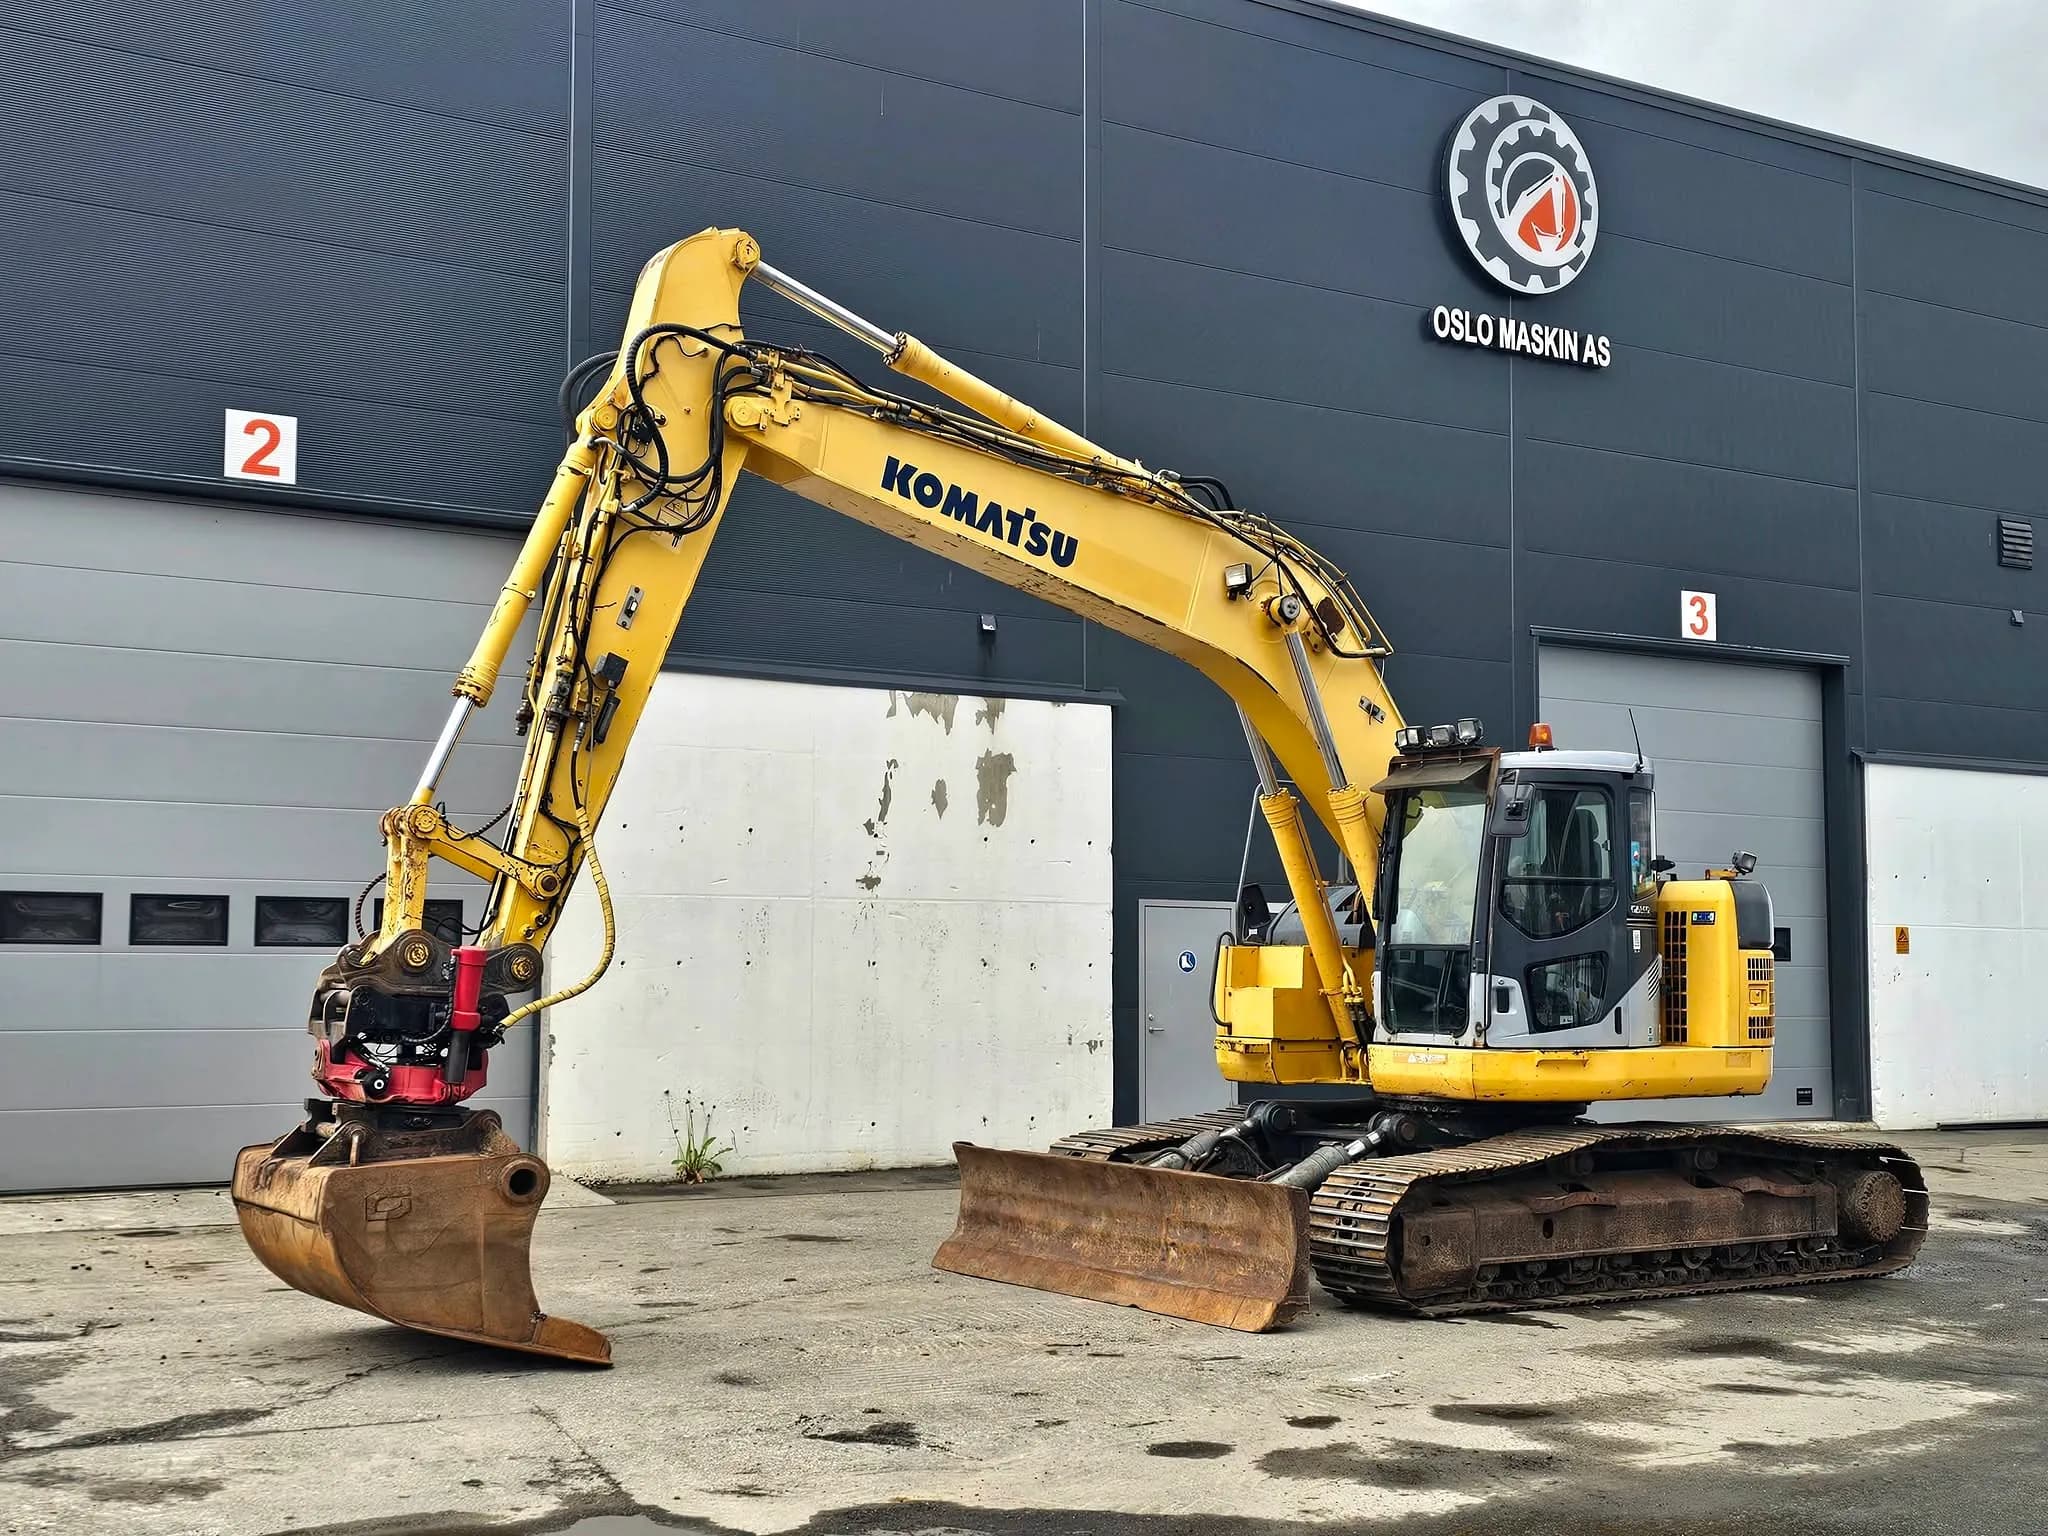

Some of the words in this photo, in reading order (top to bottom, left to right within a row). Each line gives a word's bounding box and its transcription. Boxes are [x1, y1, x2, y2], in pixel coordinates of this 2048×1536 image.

[1433, 305, 1494, 346] OSLO
[1499, 317, 1578, 362] MASKIN
[1582, 334, 1611, 367] AS
[241, 419, 281, 476] 2
[881, 455, 1079, 567] KOMATSU
[1689, 595, 1709, 636] 3
